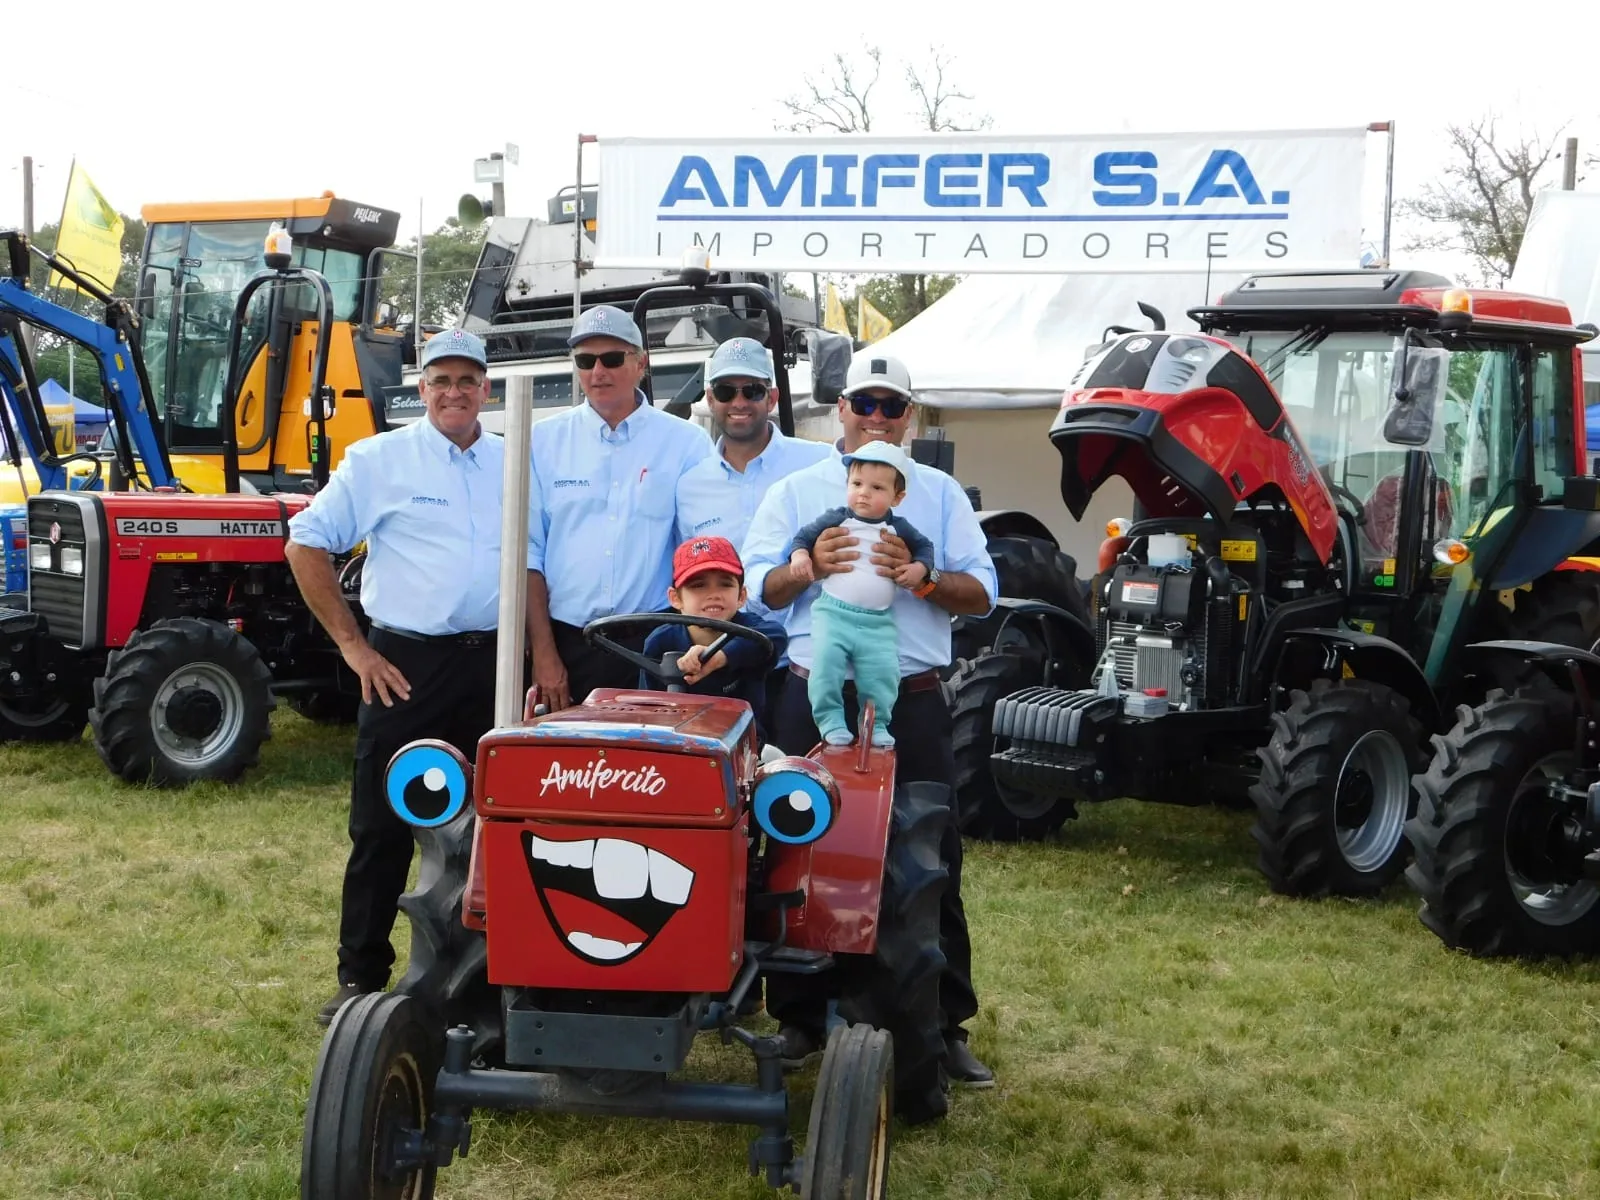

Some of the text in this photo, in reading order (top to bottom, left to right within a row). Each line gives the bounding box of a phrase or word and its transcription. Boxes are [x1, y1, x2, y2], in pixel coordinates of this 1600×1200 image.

[658, 149, 1290, 207] AMIFER S.A.
[656, 231, 1289, 258] IMPORTADORES
[220, 522, 276, 534] HATTAT
[539, 758, 666, 799] Amifercito
